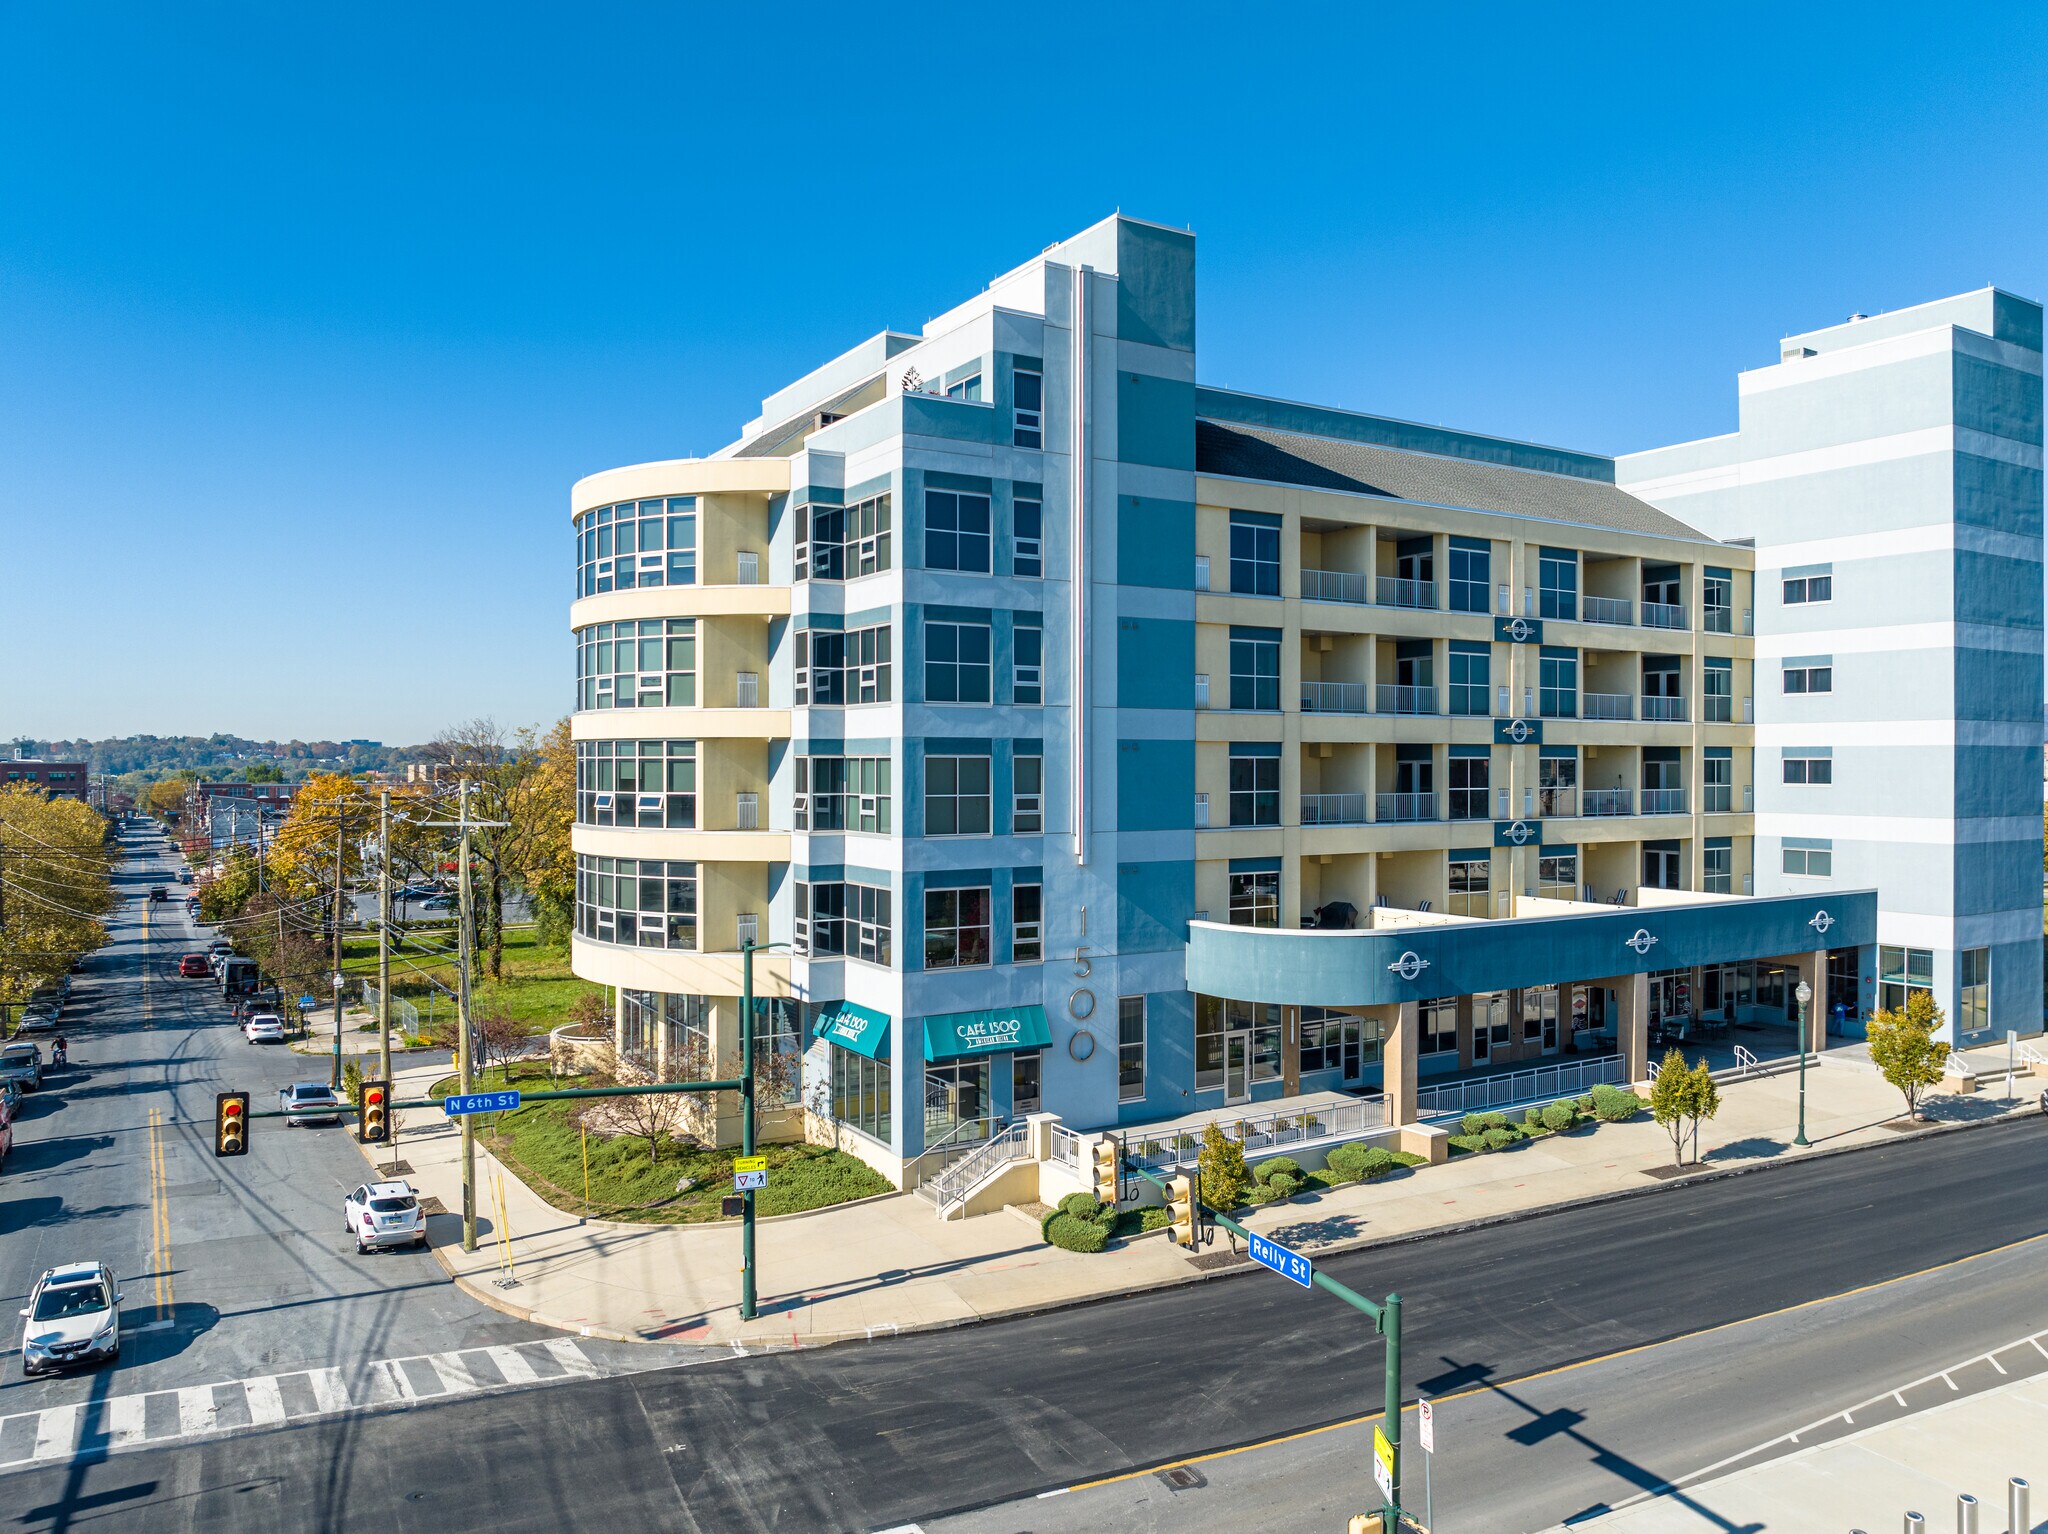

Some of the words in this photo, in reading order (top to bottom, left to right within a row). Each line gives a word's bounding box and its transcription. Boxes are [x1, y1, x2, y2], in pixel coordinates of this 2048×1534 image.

[1069, 905, 1097, 1062] 1500
[956, 1021, 987, 1037] CAFÉ
[989, 1020, 1021, 1034] 1500
[451, 1100, 460, 1110] N
[466, 1098, 492, 1109] 6th
[498, 1095, 514, 1106] St
[1253, 1238, 1286, 1271] Reily
[1291, 1257, 1306, 1279] St
